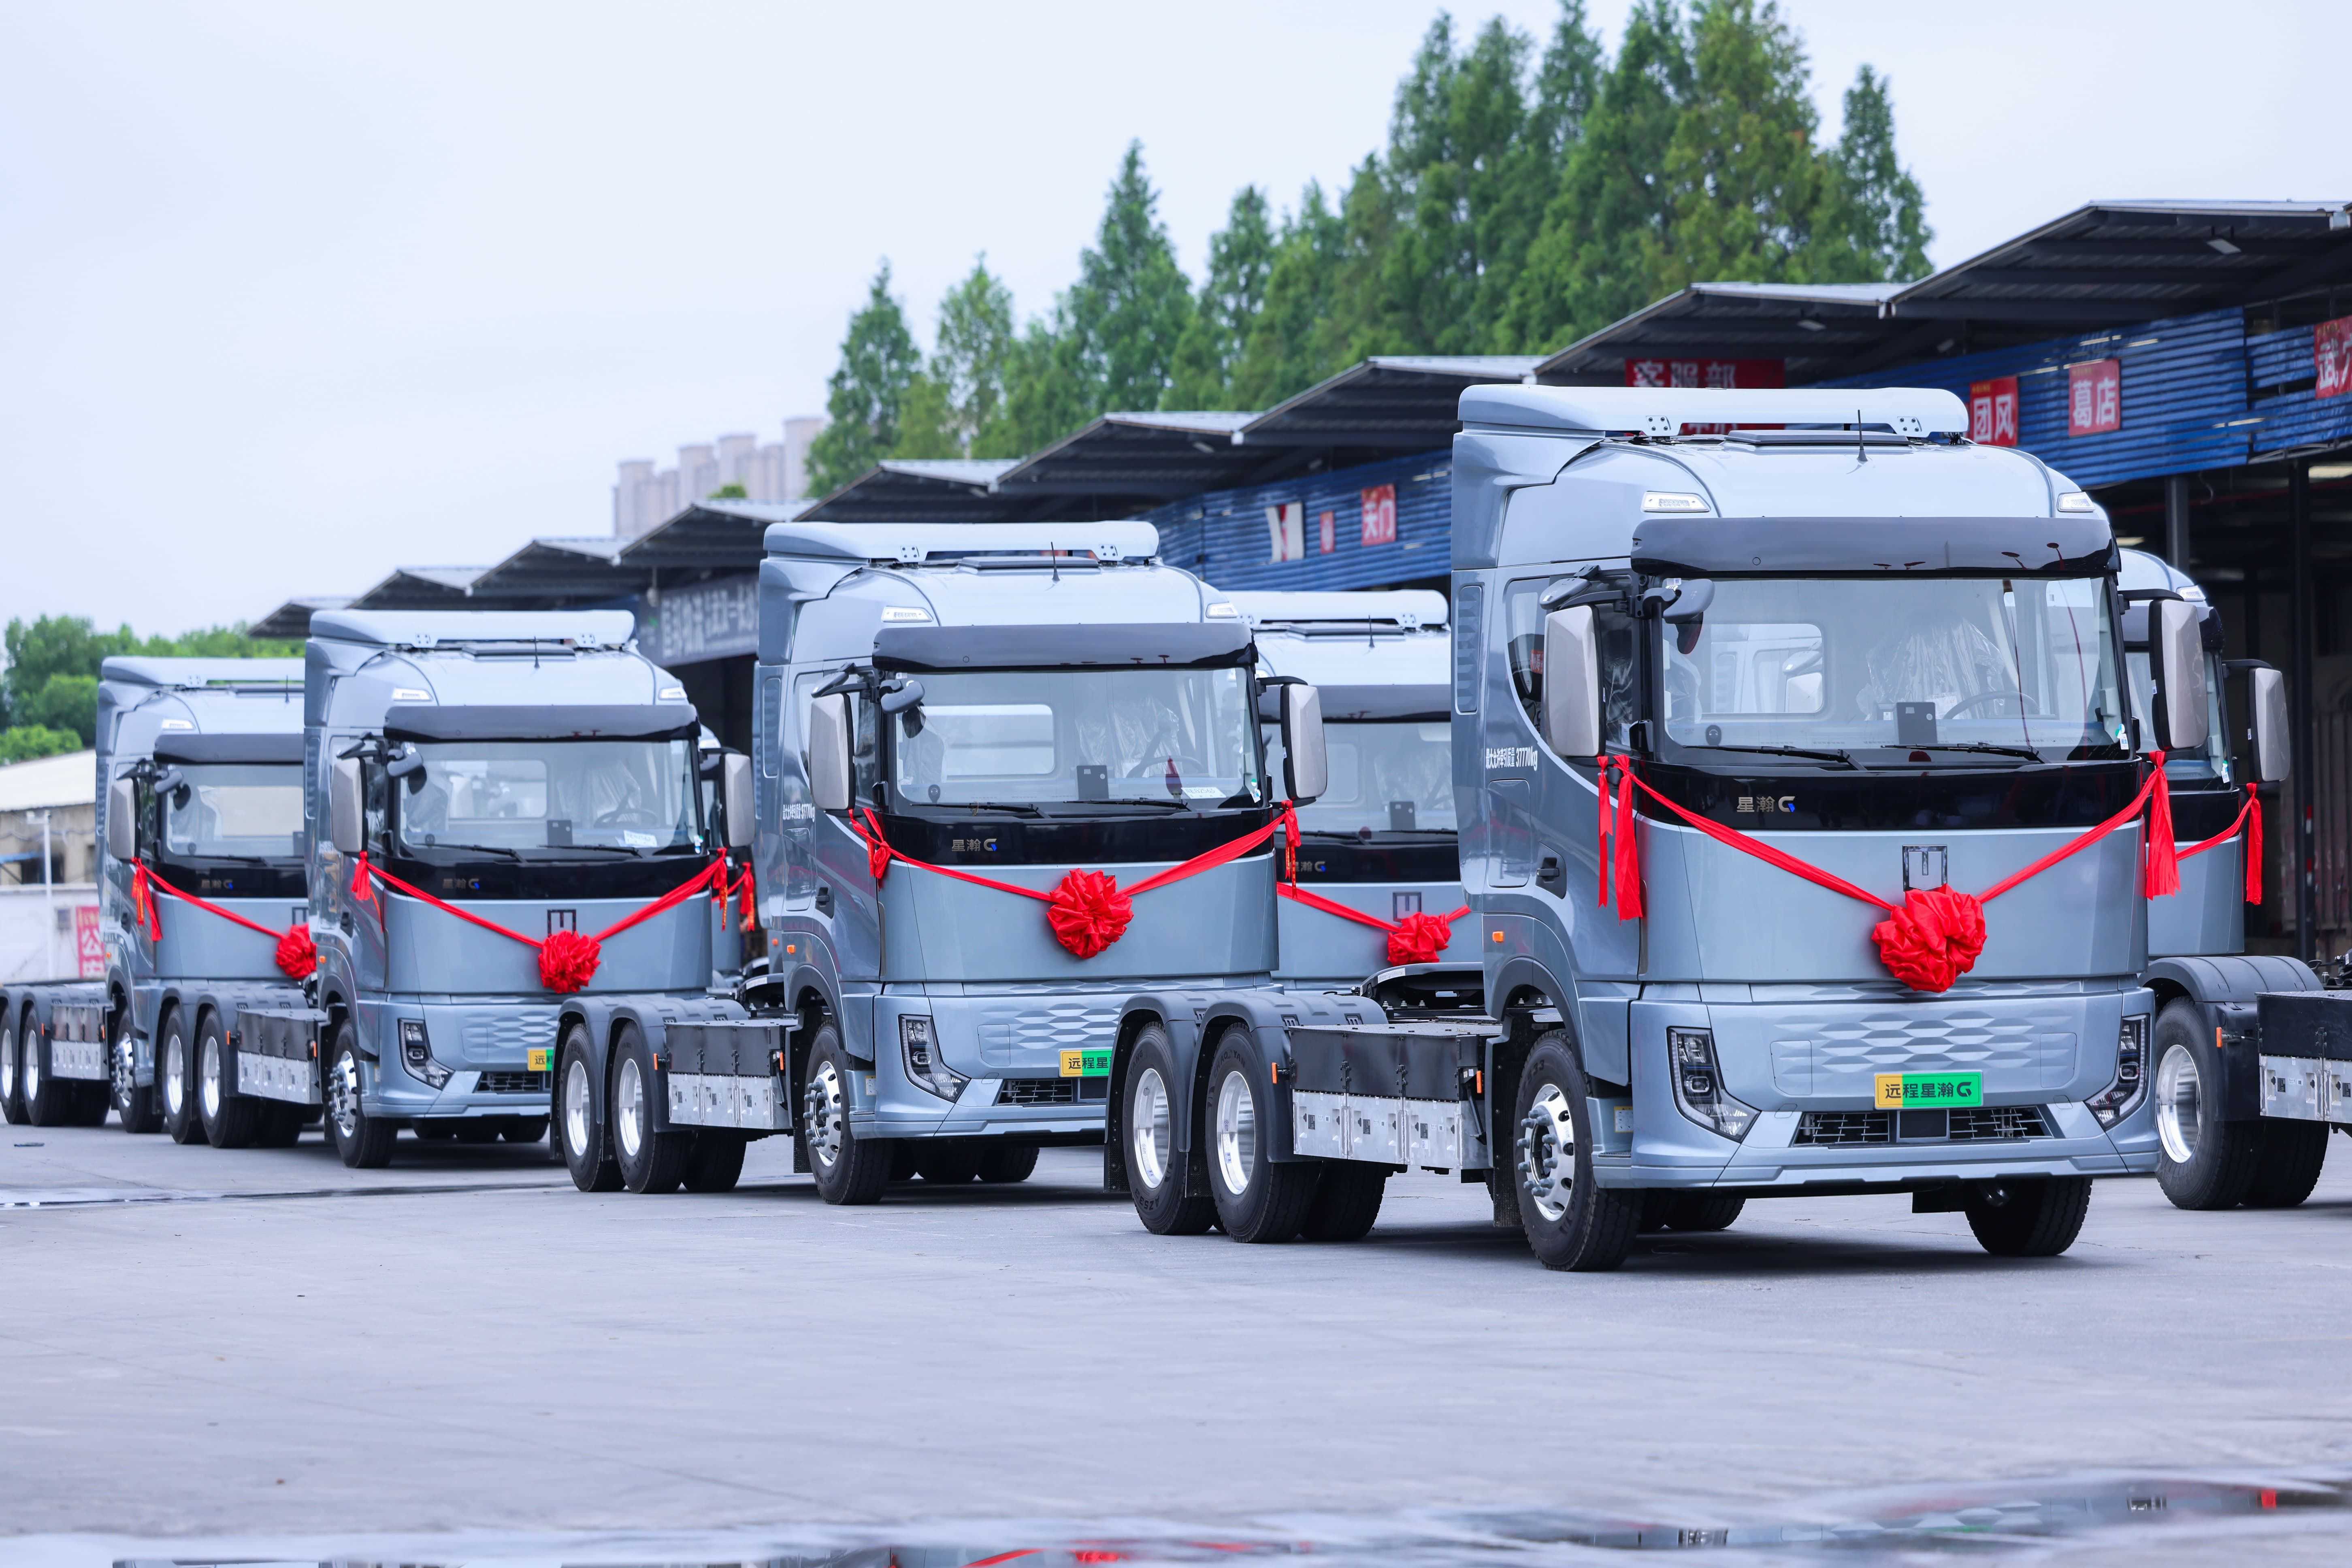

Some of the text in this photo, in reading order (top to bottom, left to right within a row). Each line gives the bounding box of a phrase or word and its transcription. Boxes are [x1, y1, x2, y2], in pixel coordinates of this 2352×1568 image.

[1633, 361, 1736, 388] 客服部
[2073, 377, 2116, 428] 葛店
[1973, 394, 2014, 443] 团风
[1516, 746, 1538, 771] 37770kg
[801, 803, 815, 822] 37770kg
[1068, 1057, 1112, 1069] 远程星
